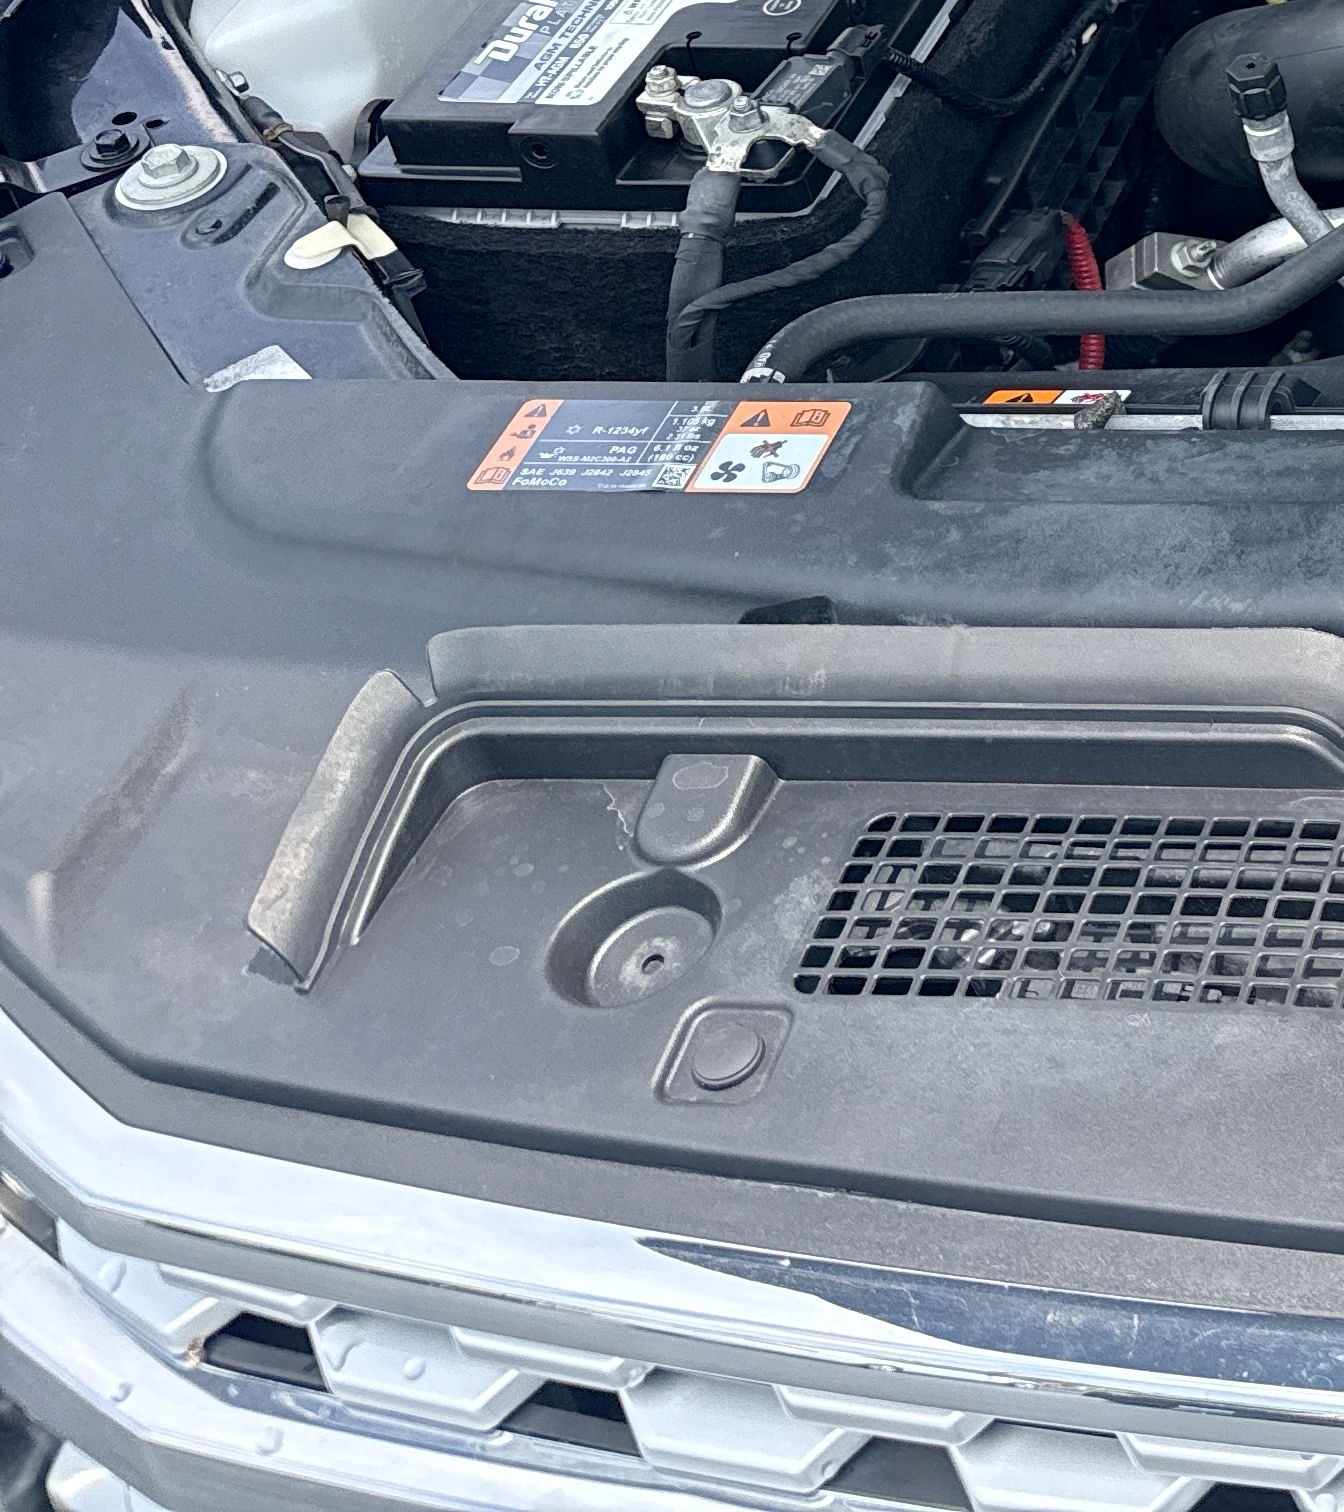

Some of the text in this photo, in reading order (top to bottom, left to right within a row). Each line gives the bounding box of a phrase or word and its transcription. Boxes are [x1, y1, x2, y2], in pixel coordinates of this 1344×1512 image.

[534, 33, 567, 70] AGM
[701, 417, 716, 426] kg
[592, 425, 649, 437] R-1234yf
[609, 446, 637, 455] PAG
[675, 454, 695, 463] cc)
[519, 468, 545, 476] SAE
[550, 468, 577, 476] J639
[511, 477, 568, 487] FoMoCo
